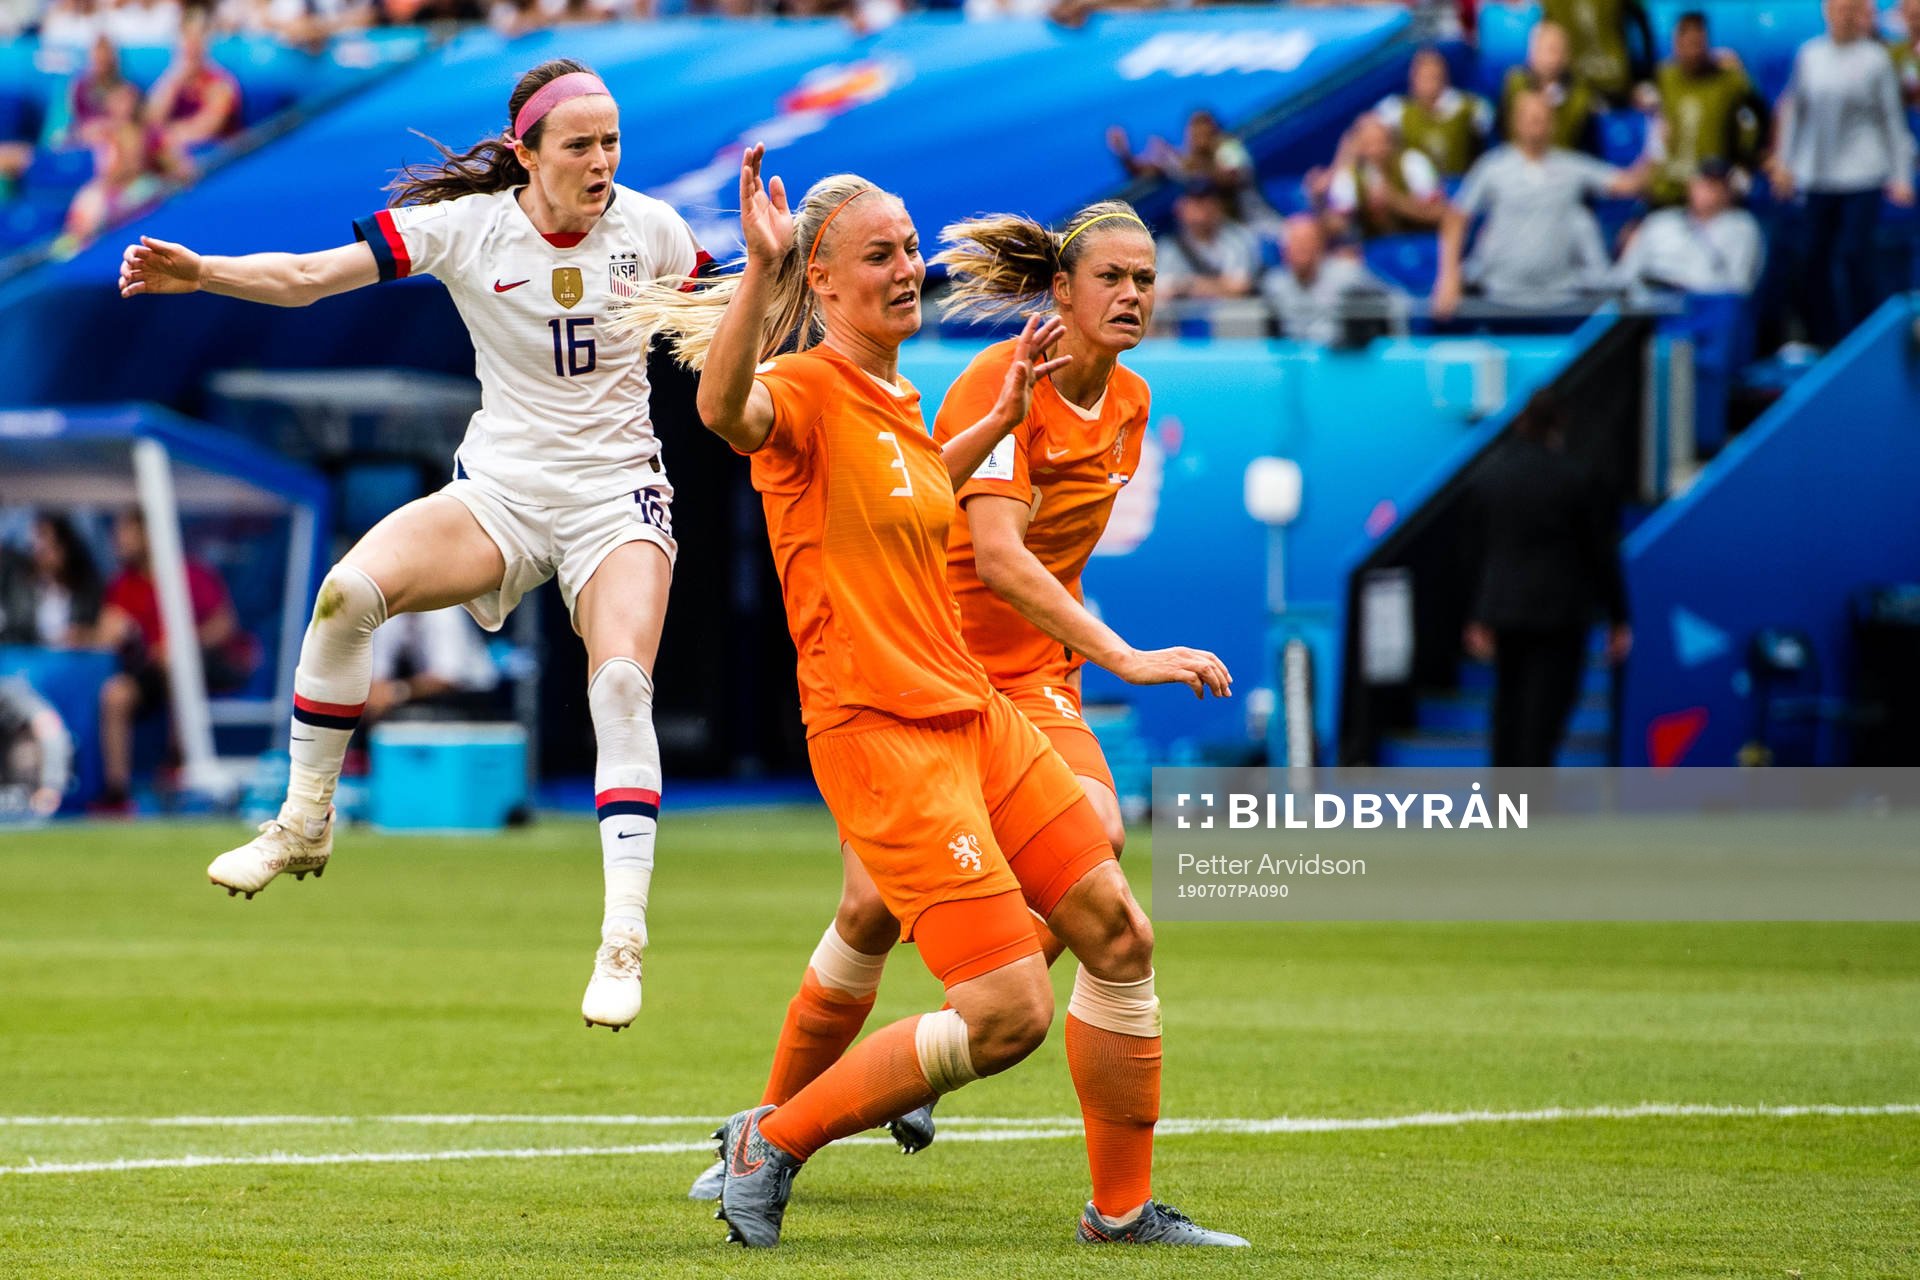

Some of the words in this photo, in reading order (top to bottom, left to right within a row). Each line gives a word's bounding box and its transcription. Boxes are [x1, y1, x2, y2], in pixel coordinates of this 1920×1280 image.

[612, 264, 636, 279] USA
[547, 316, 597, 377] 16
[877, 431, 914, 497] 3
[633, 487, 668, 534] 16
